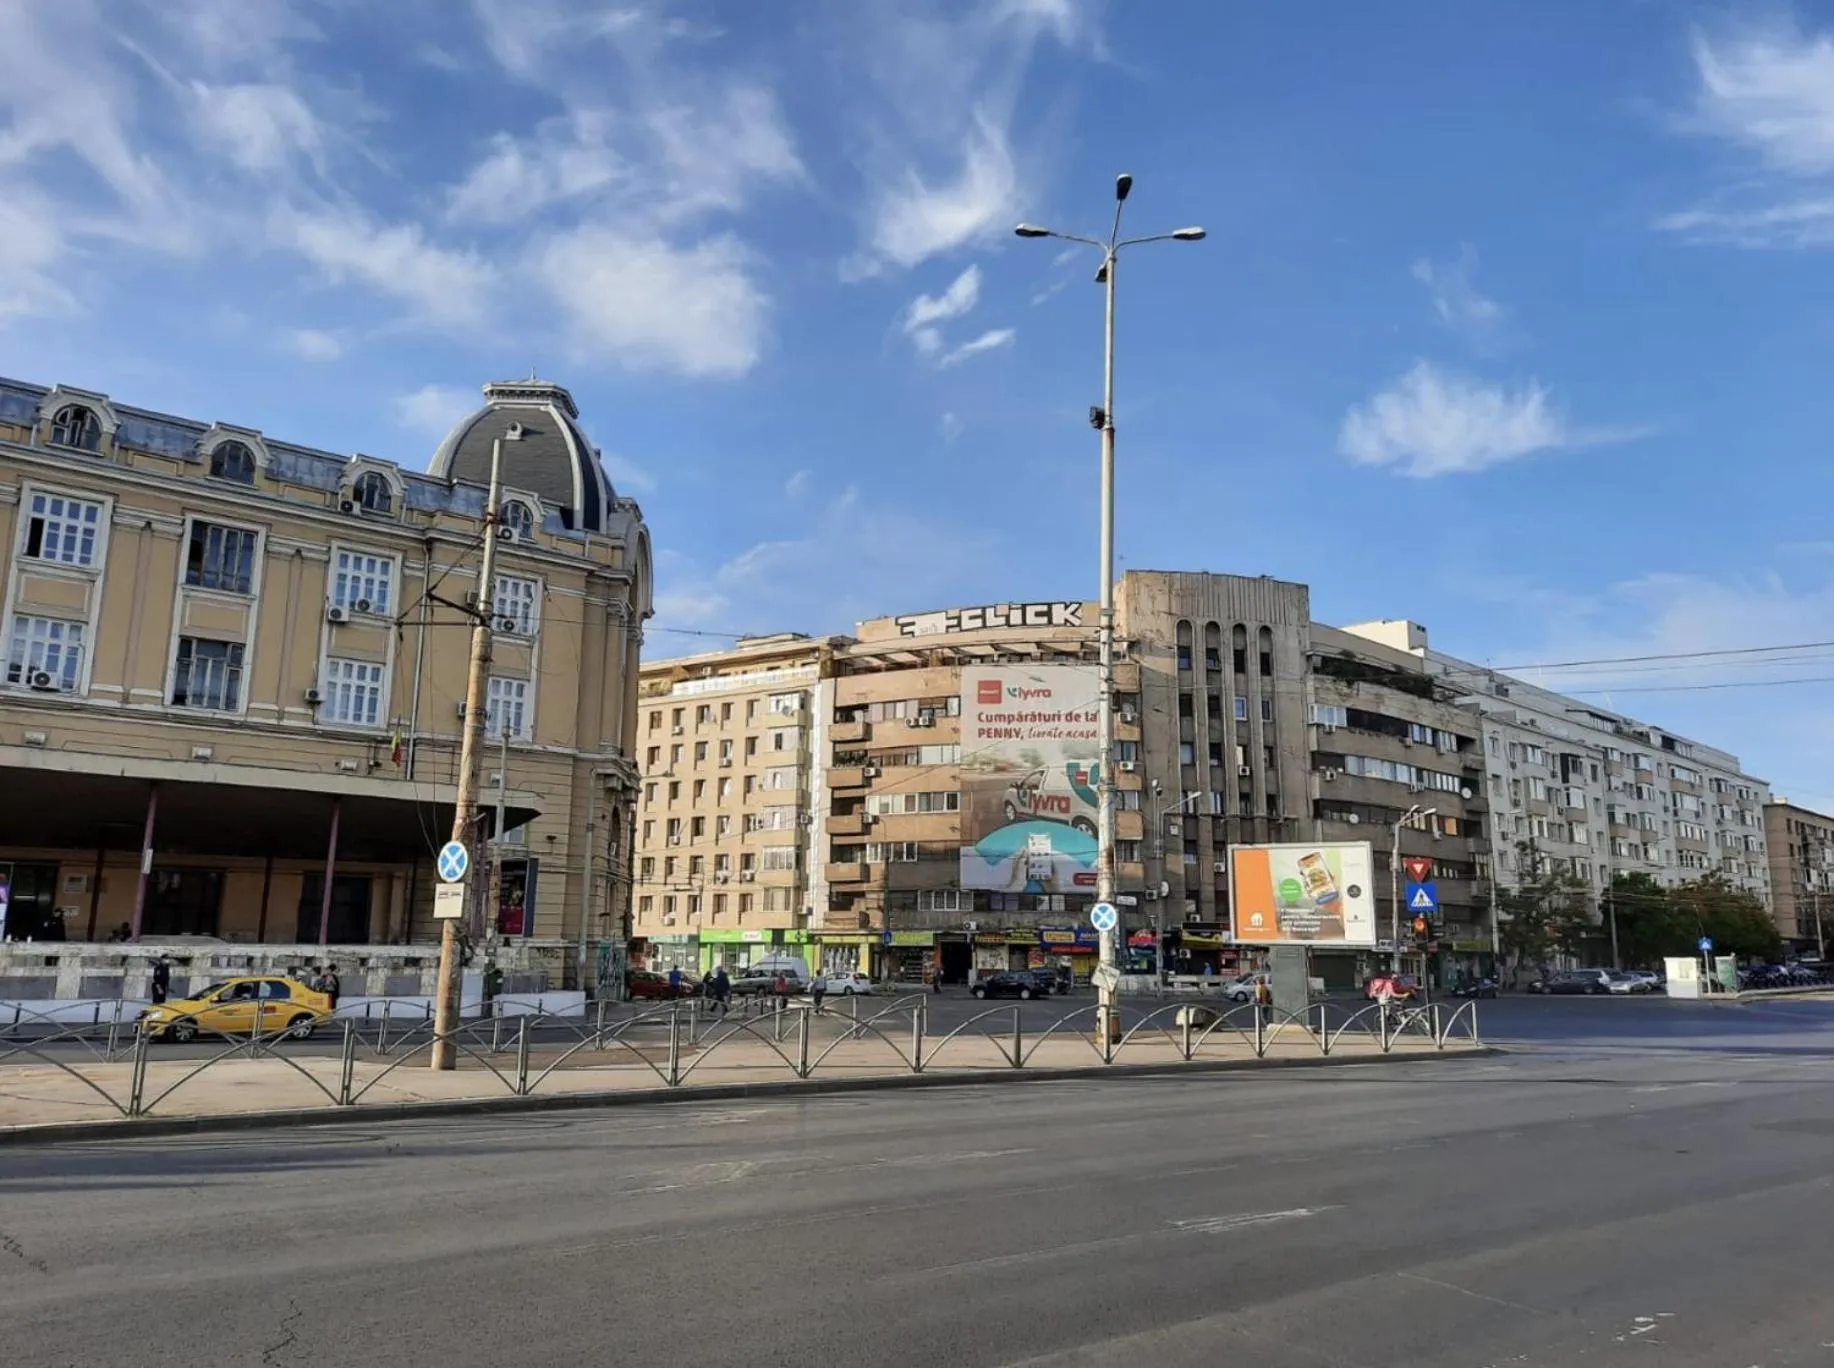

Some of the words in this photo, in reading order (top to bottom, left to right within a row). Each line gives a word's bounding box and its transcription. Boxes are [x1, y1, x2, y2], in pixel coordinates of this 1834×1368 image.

[1018, 686, 1052, 700] lyvra
[1064, 712, 1082, 723] de
[1028, 790, 1071, 815] lyvra
